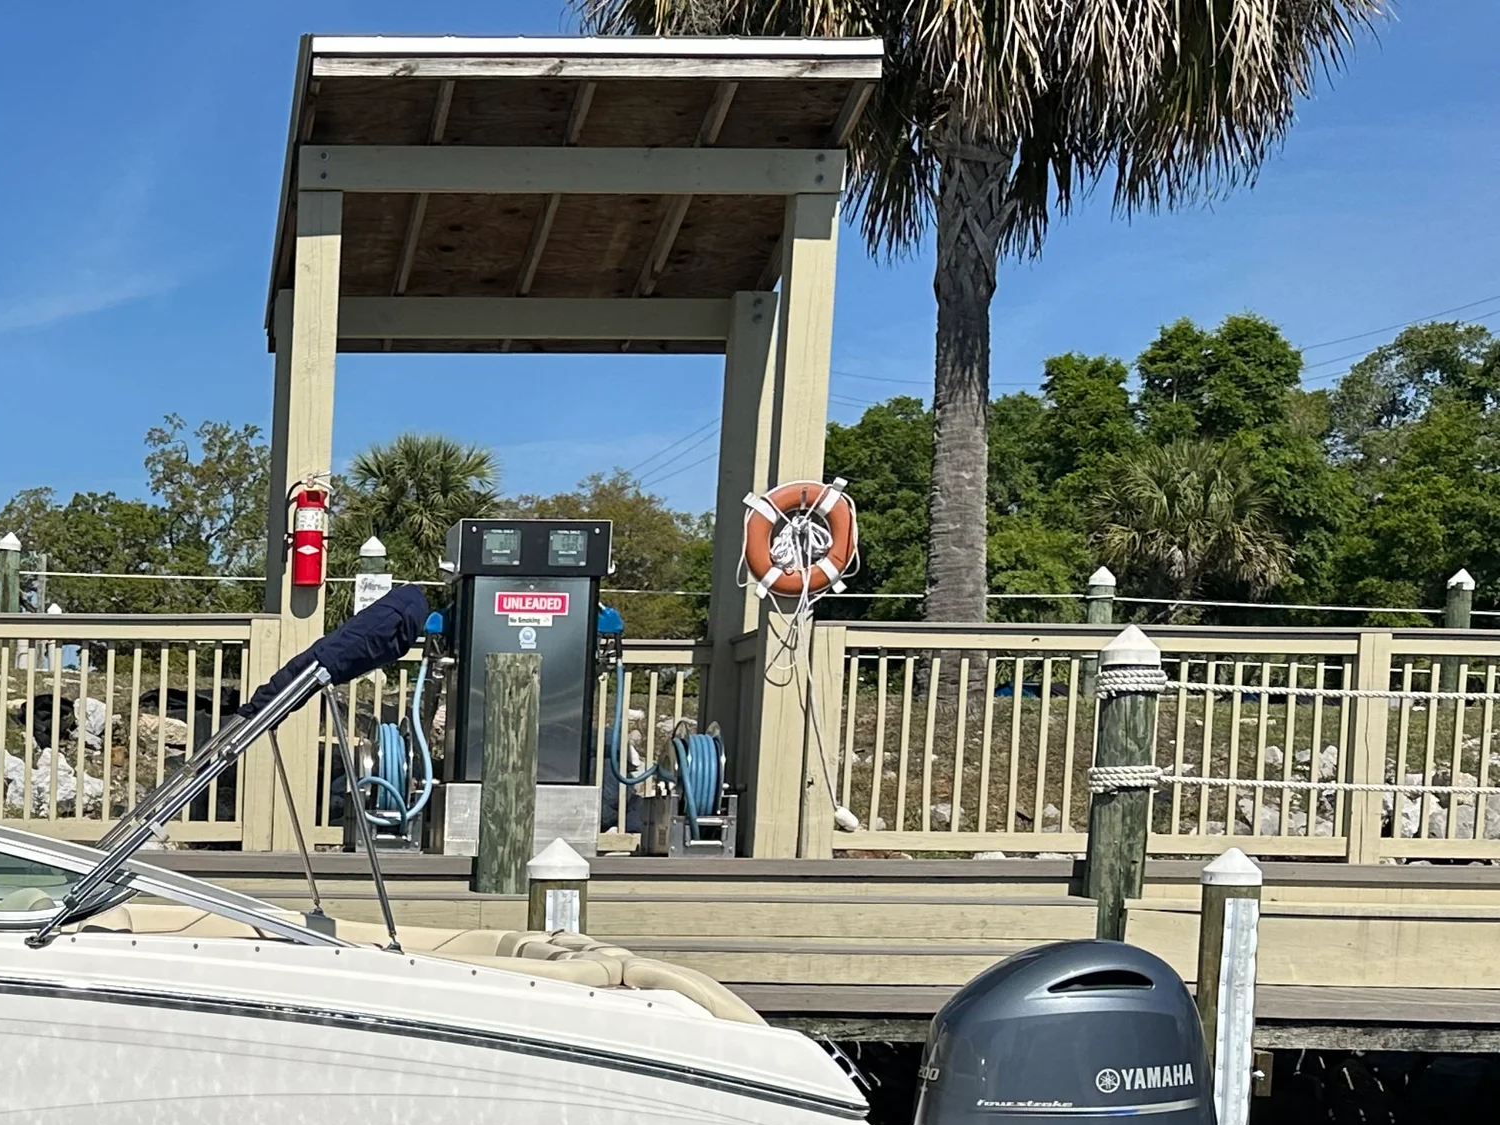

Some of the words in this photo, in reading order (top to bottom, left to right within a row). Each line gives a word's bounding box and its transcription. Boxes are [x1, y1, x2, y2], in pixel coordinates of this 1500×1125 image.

[502, 596, 562, 610] UNLEADED
[518, 616, 541, 625] Smoking
[1121, 1063, 1194, 1091] YAMAHA
